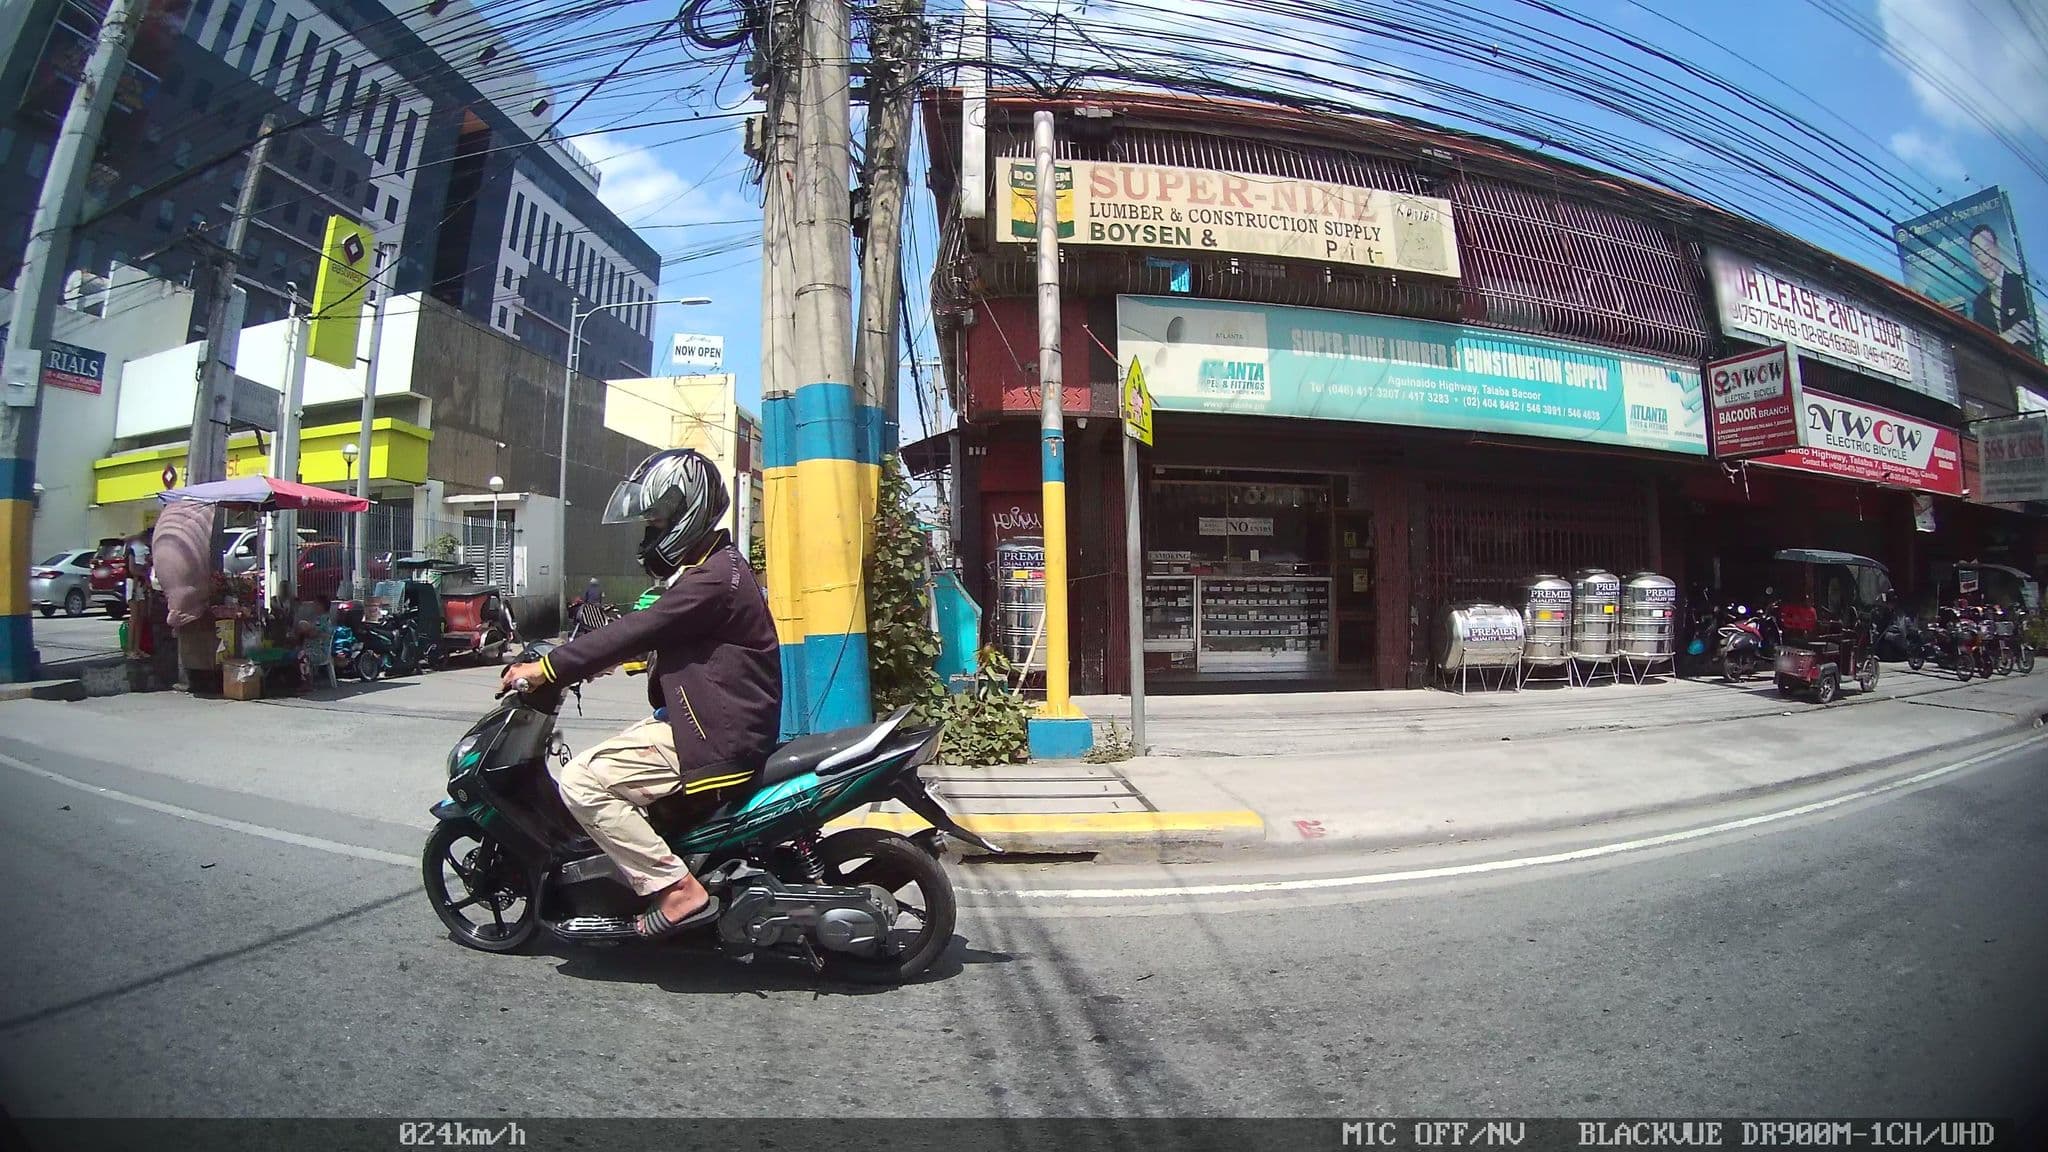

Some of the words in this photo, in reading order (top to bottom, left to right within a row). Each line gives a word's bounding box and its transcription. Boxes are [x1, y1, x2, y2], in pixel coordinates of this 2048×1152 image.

[1013, 169, 1071, 182] BOEN
[1089, 165, 1377, 222] SUPER-NINE
[1089, 202, 1164, 221] LUMBER
[1170, 207, 1182, 223] &
[1188, 208, 1318, 234] CONSTRUCTION
[1324, 221, 1381, 242] SUPPLY
[1090, 222, 1192, 246] BOYSEN
[1201, 229, 1218, 247] &
[1762, 273, 1825, 323] LEASE
[1826, 297, 1859, 336] 2ND
[1860, 311, 1904, 352] FLOOR
[675, 346, 696, 356] NOW
[698, 347, 721, 358] OPEN
[1389, 338, 1449, 370] LUMBER
[1464, 346, 1563, 385] CONSTRUCTION
[1565, 360, 1608, 391] SUPPLY
[1231, 380, 1265, 391] FITTINGS
[1463, 397, 1481, 409] (02)
[1631, 404, 1668, 424] ATLANTA
[1719, 407, 1758, 424] BACOOR
[1759, 405, 1790, 418] BRANCH
[1811, 449, 1848, 464] Highway,
[1826, 433, 1871, 453] ELECTRIC
[1873, 442, 1908, 461] BICYCLE
[1229, 521, 1249, 533] NO
[1471, 627, 1517, 637] PREMIER
